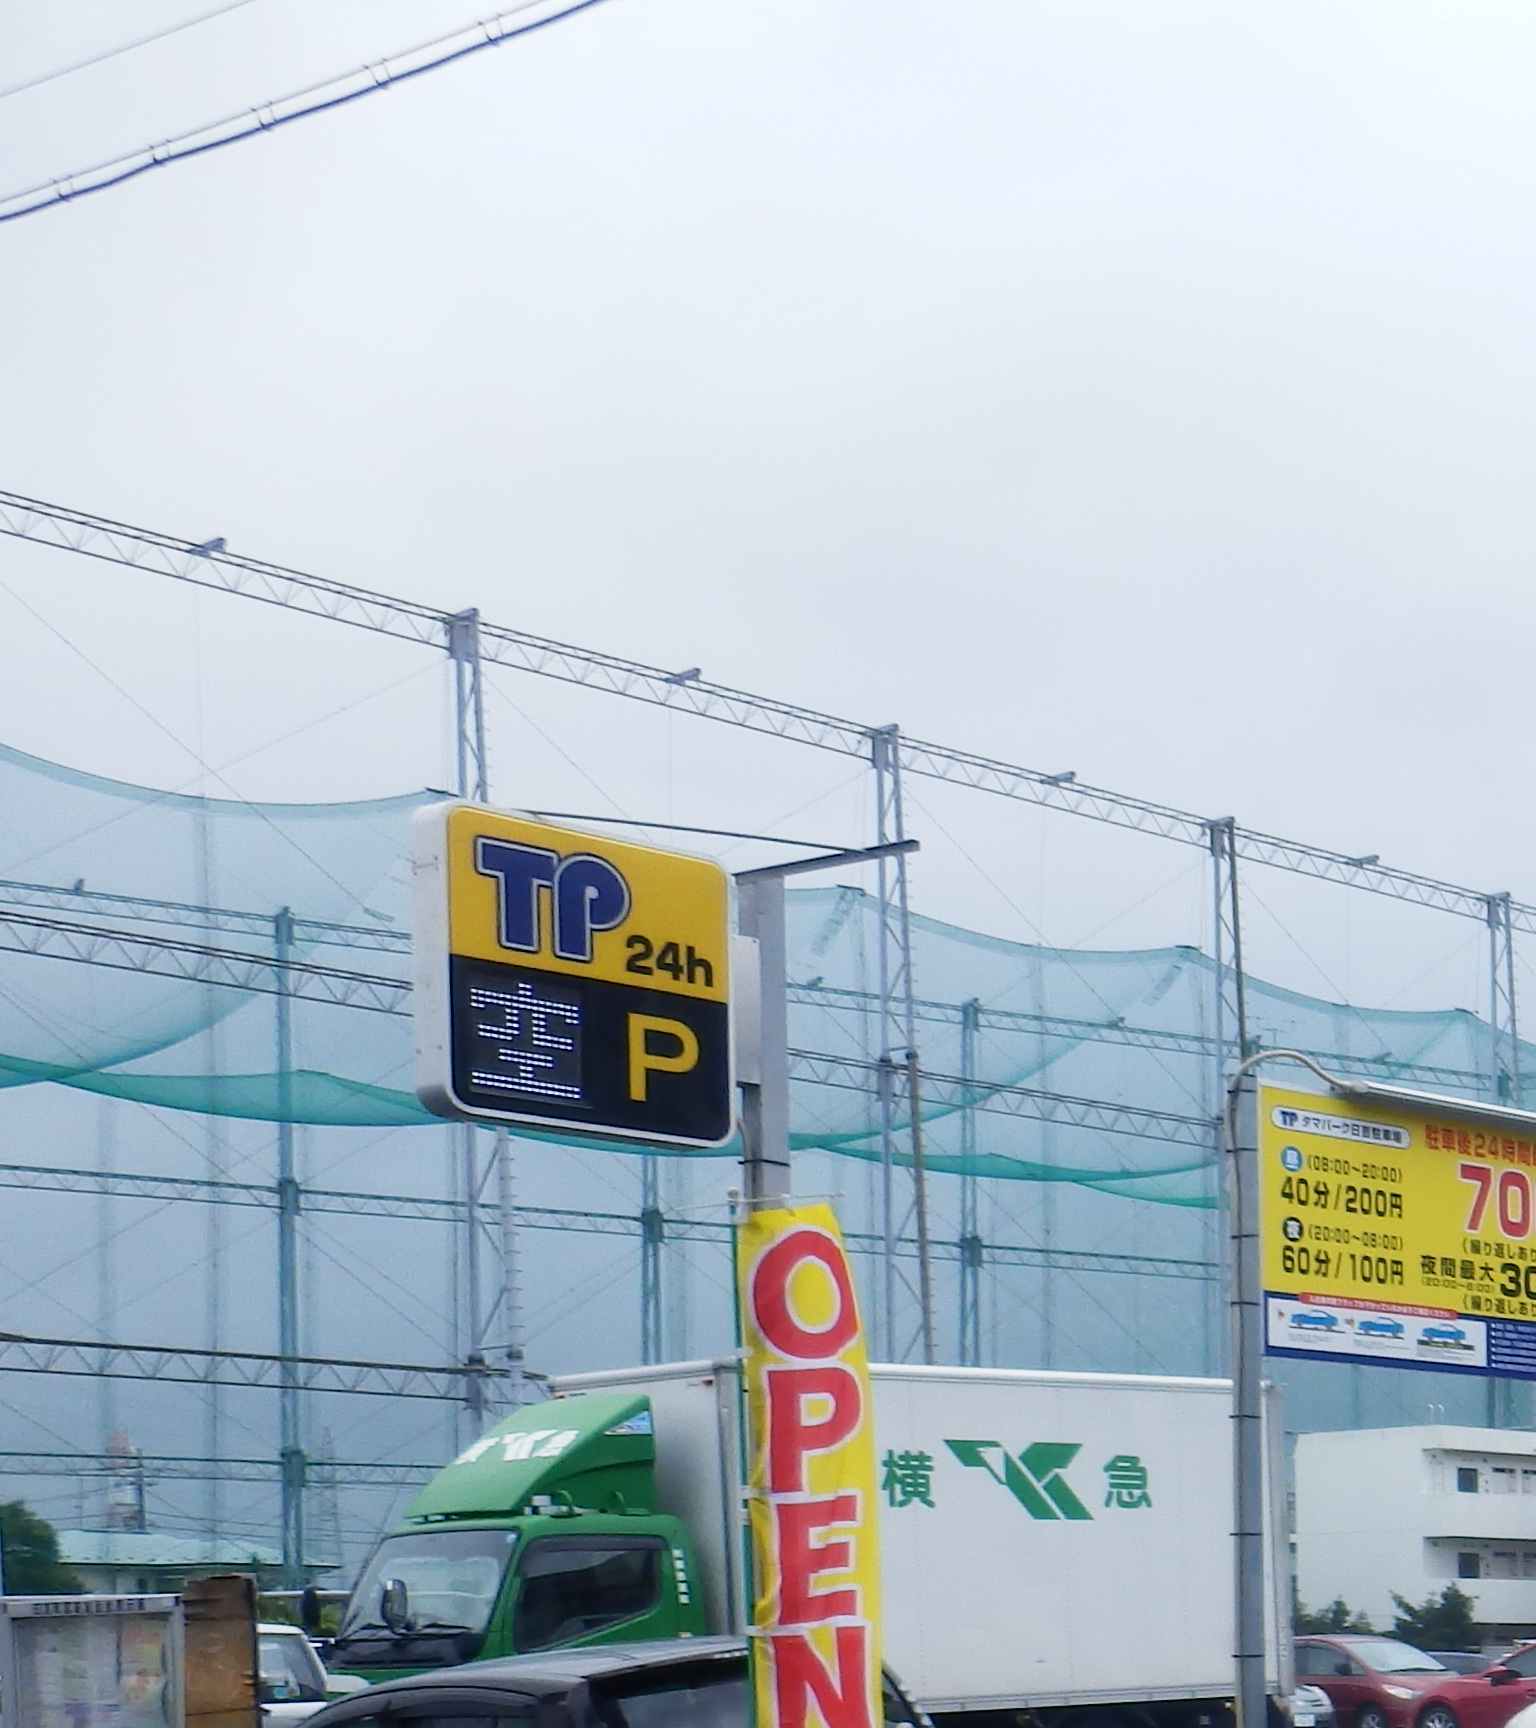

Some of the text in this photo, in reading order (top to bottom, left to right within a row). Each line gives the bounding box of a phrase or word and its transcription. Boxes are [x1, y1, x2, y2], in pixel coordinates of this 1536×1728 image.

[474, 835, 630, 962] TP
[625, 936, 713, 988] 24h
[627, 1012, 699, 1102] P
[882, 1450, 935, 1509] 横
[1103, 1455, 1153, 1510] 急
